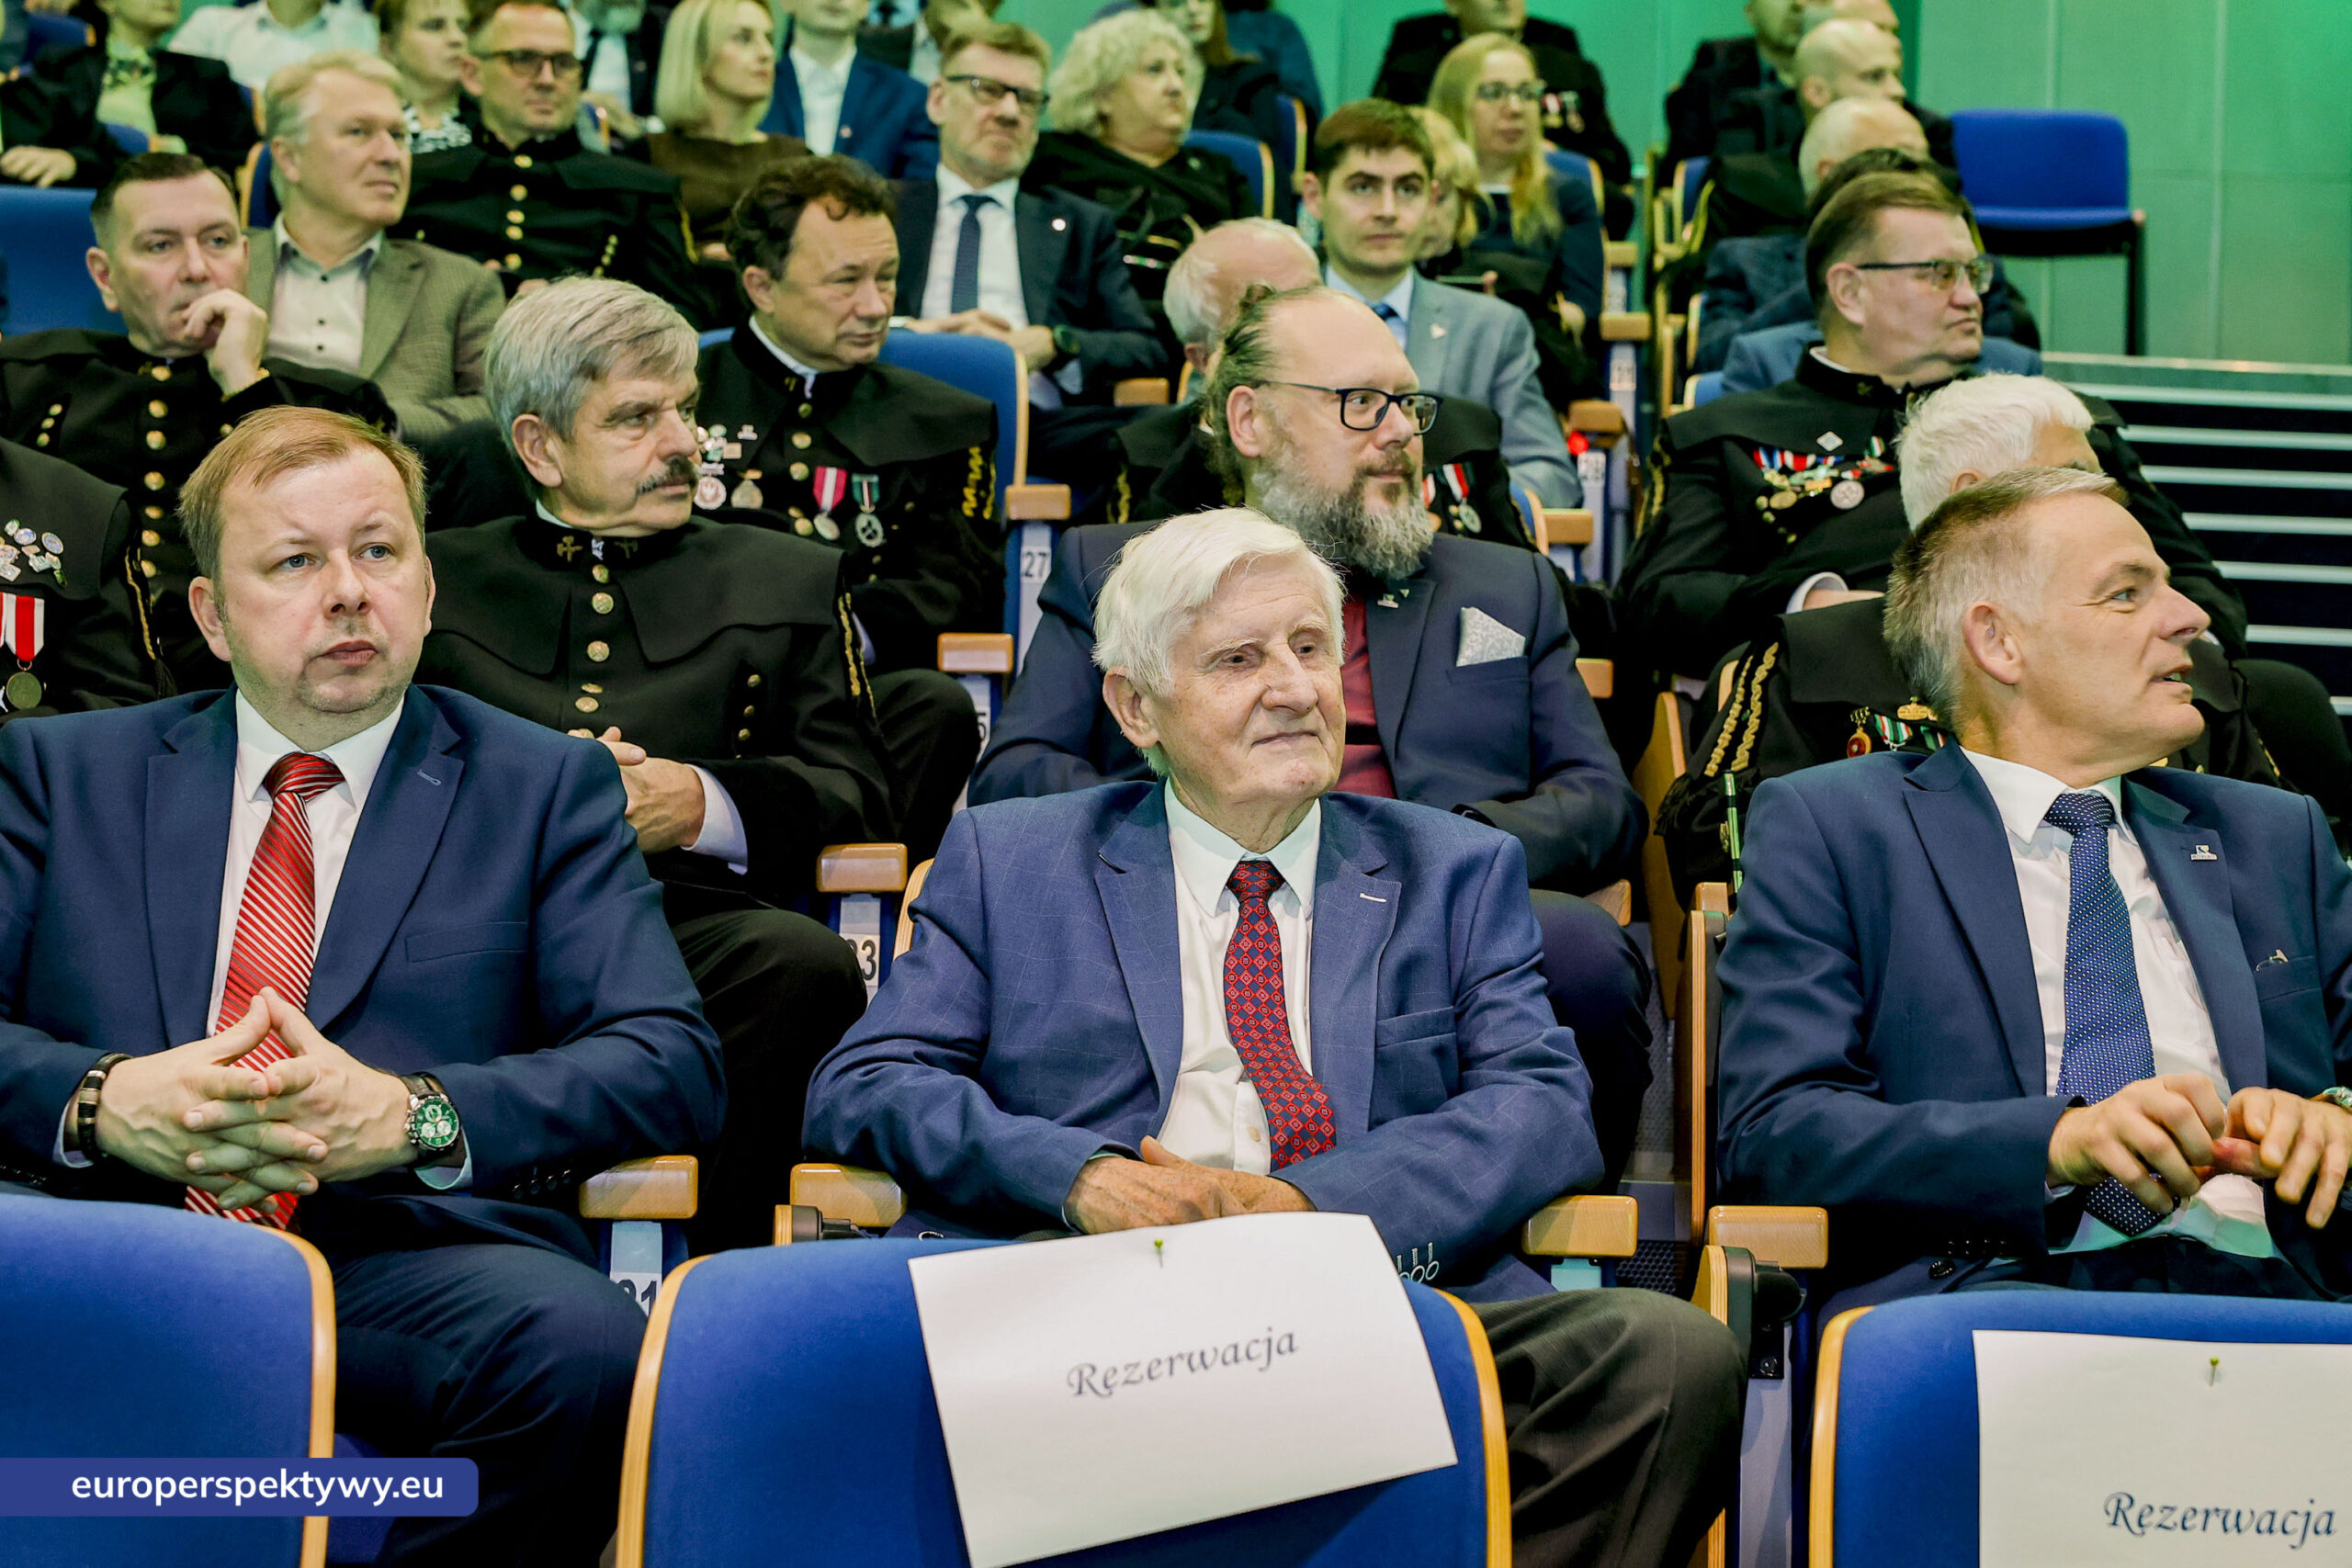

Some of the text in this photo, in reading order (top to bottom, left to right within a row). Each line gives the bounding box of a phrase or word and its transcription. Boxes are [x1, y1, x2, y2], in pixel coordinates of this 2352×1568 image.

[1021, 551, 1049, 578] 27
[1066, 1325, 1299, 1399] Rezerwacja
[2103, 1491, 2337, 1551] Rezerwacja
